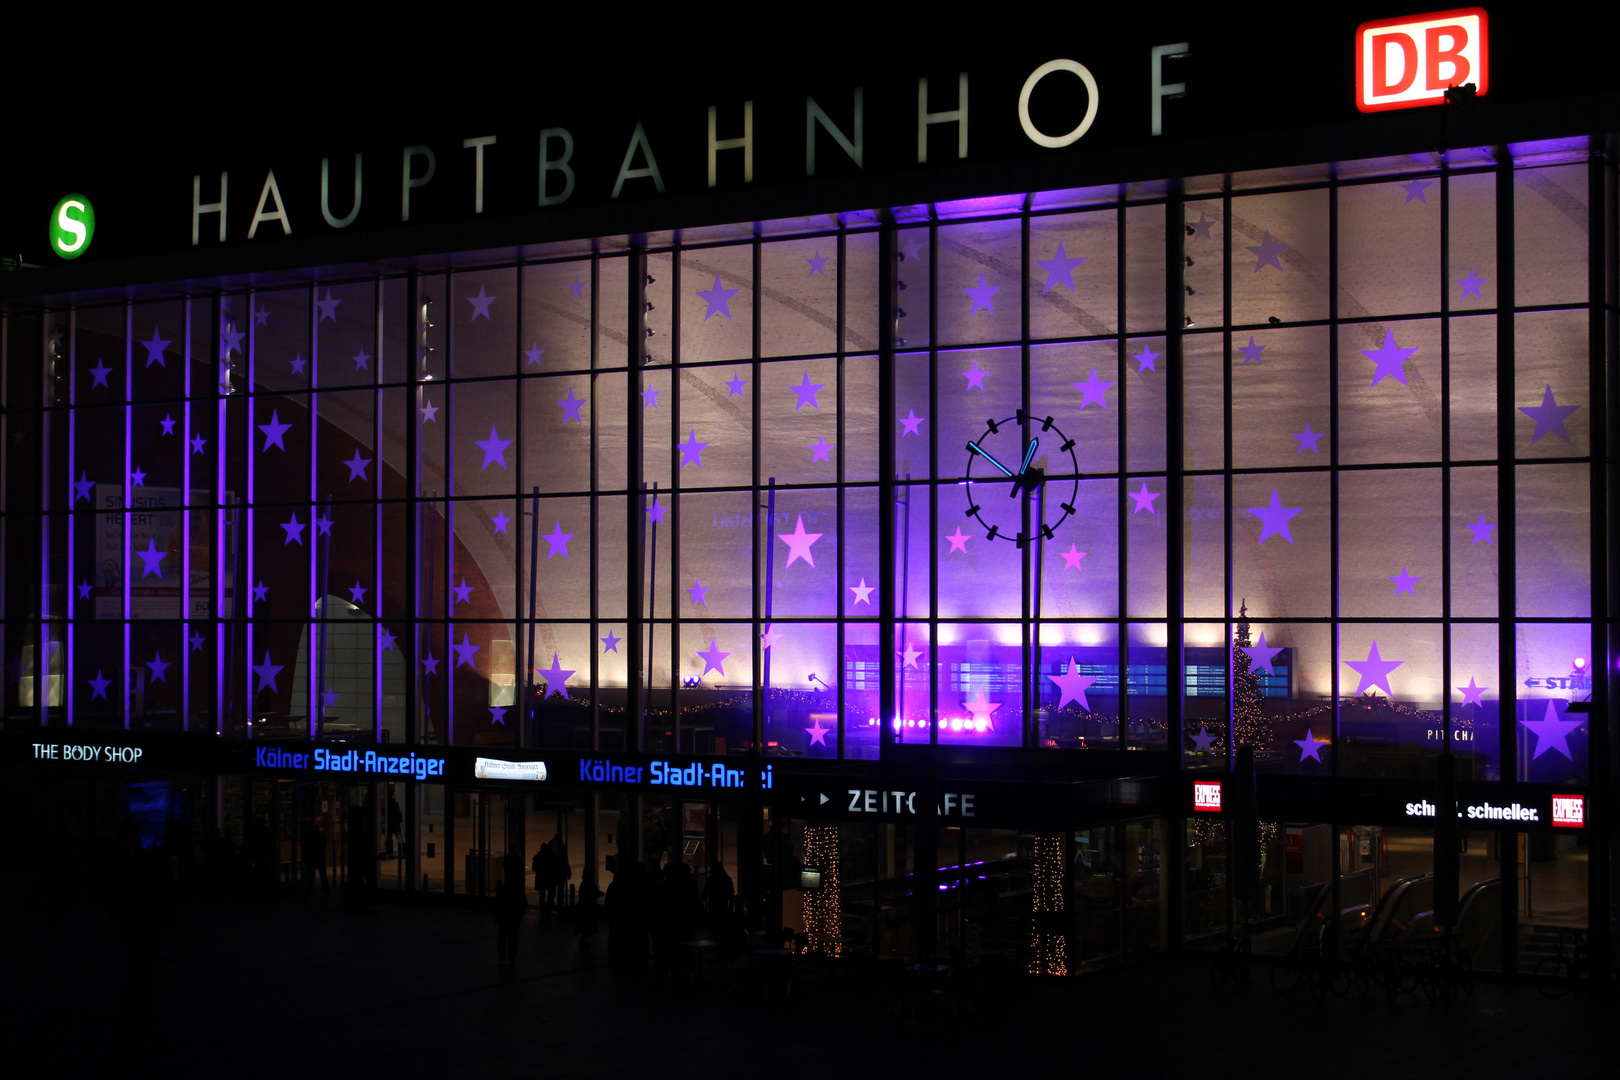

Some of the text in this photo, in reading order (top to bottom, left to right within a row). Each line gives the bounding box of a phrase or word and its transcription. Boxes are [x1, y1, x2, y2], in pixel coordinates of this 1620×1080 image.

[1372, 25, 1471, 98] DB
[190, 42, 1192, 246] HAUPTBAHNHOF
[56, 199, 88, 254] S
[106, 513, 155, 526] HEERT
[32, 743, 143, 763] THE BODY SHOP
[256, 746, 445, 781] Kölner Stadt-Anzeiger
[579, 757, 644, 784] Kölner
[847, 788, 976, 817] ZEITCFE
[1195, 784, 1221, 803] EXPRESS
[1466, 801, 1540, 822] schneller.
[1552, 798, 1583, 819] EXPRESS
